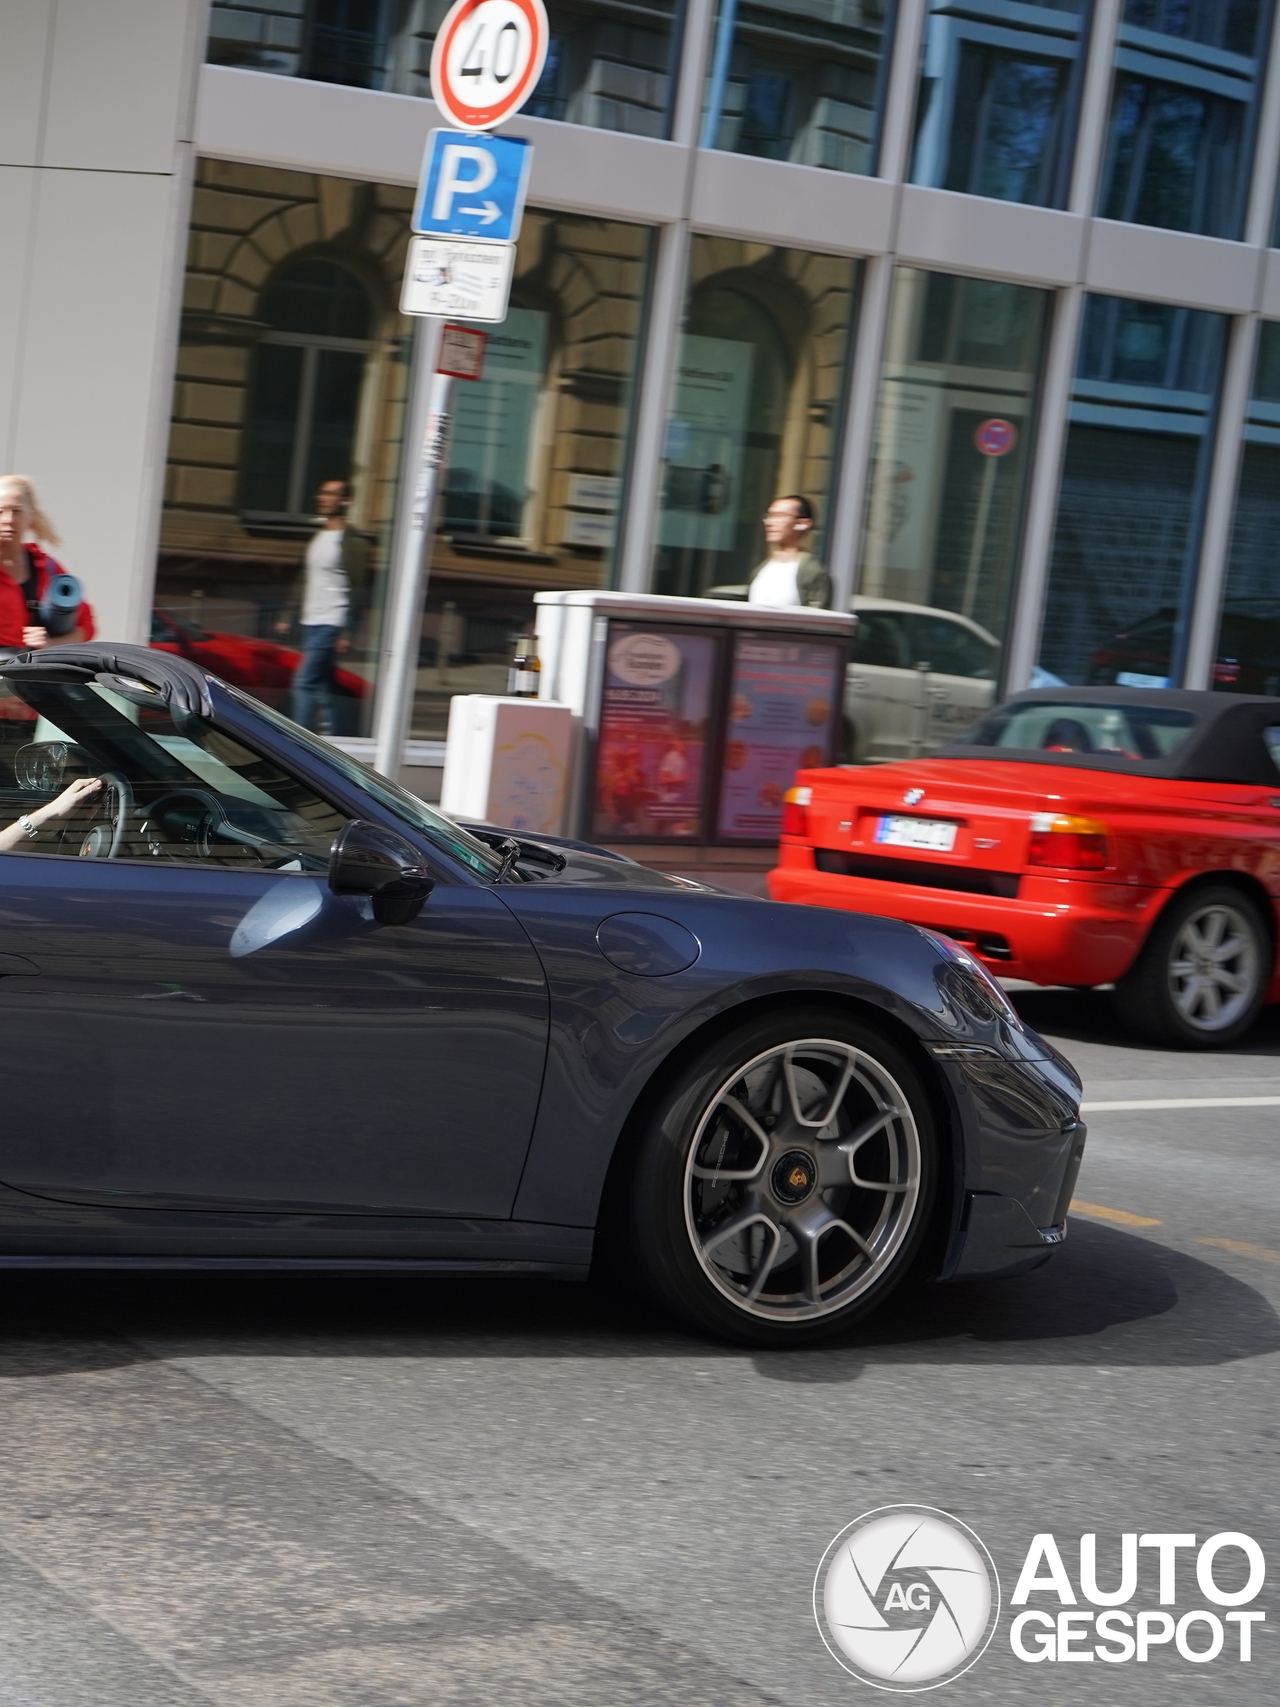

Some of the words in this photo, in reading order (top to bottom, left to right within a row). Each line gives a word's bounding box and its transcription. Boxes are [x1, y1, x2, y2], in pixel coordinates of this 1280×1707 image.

[459, 21, 520, 85] 40
[431, 144, 498, 221] P
[711, 1130, 731, 1189] PORSCHE
